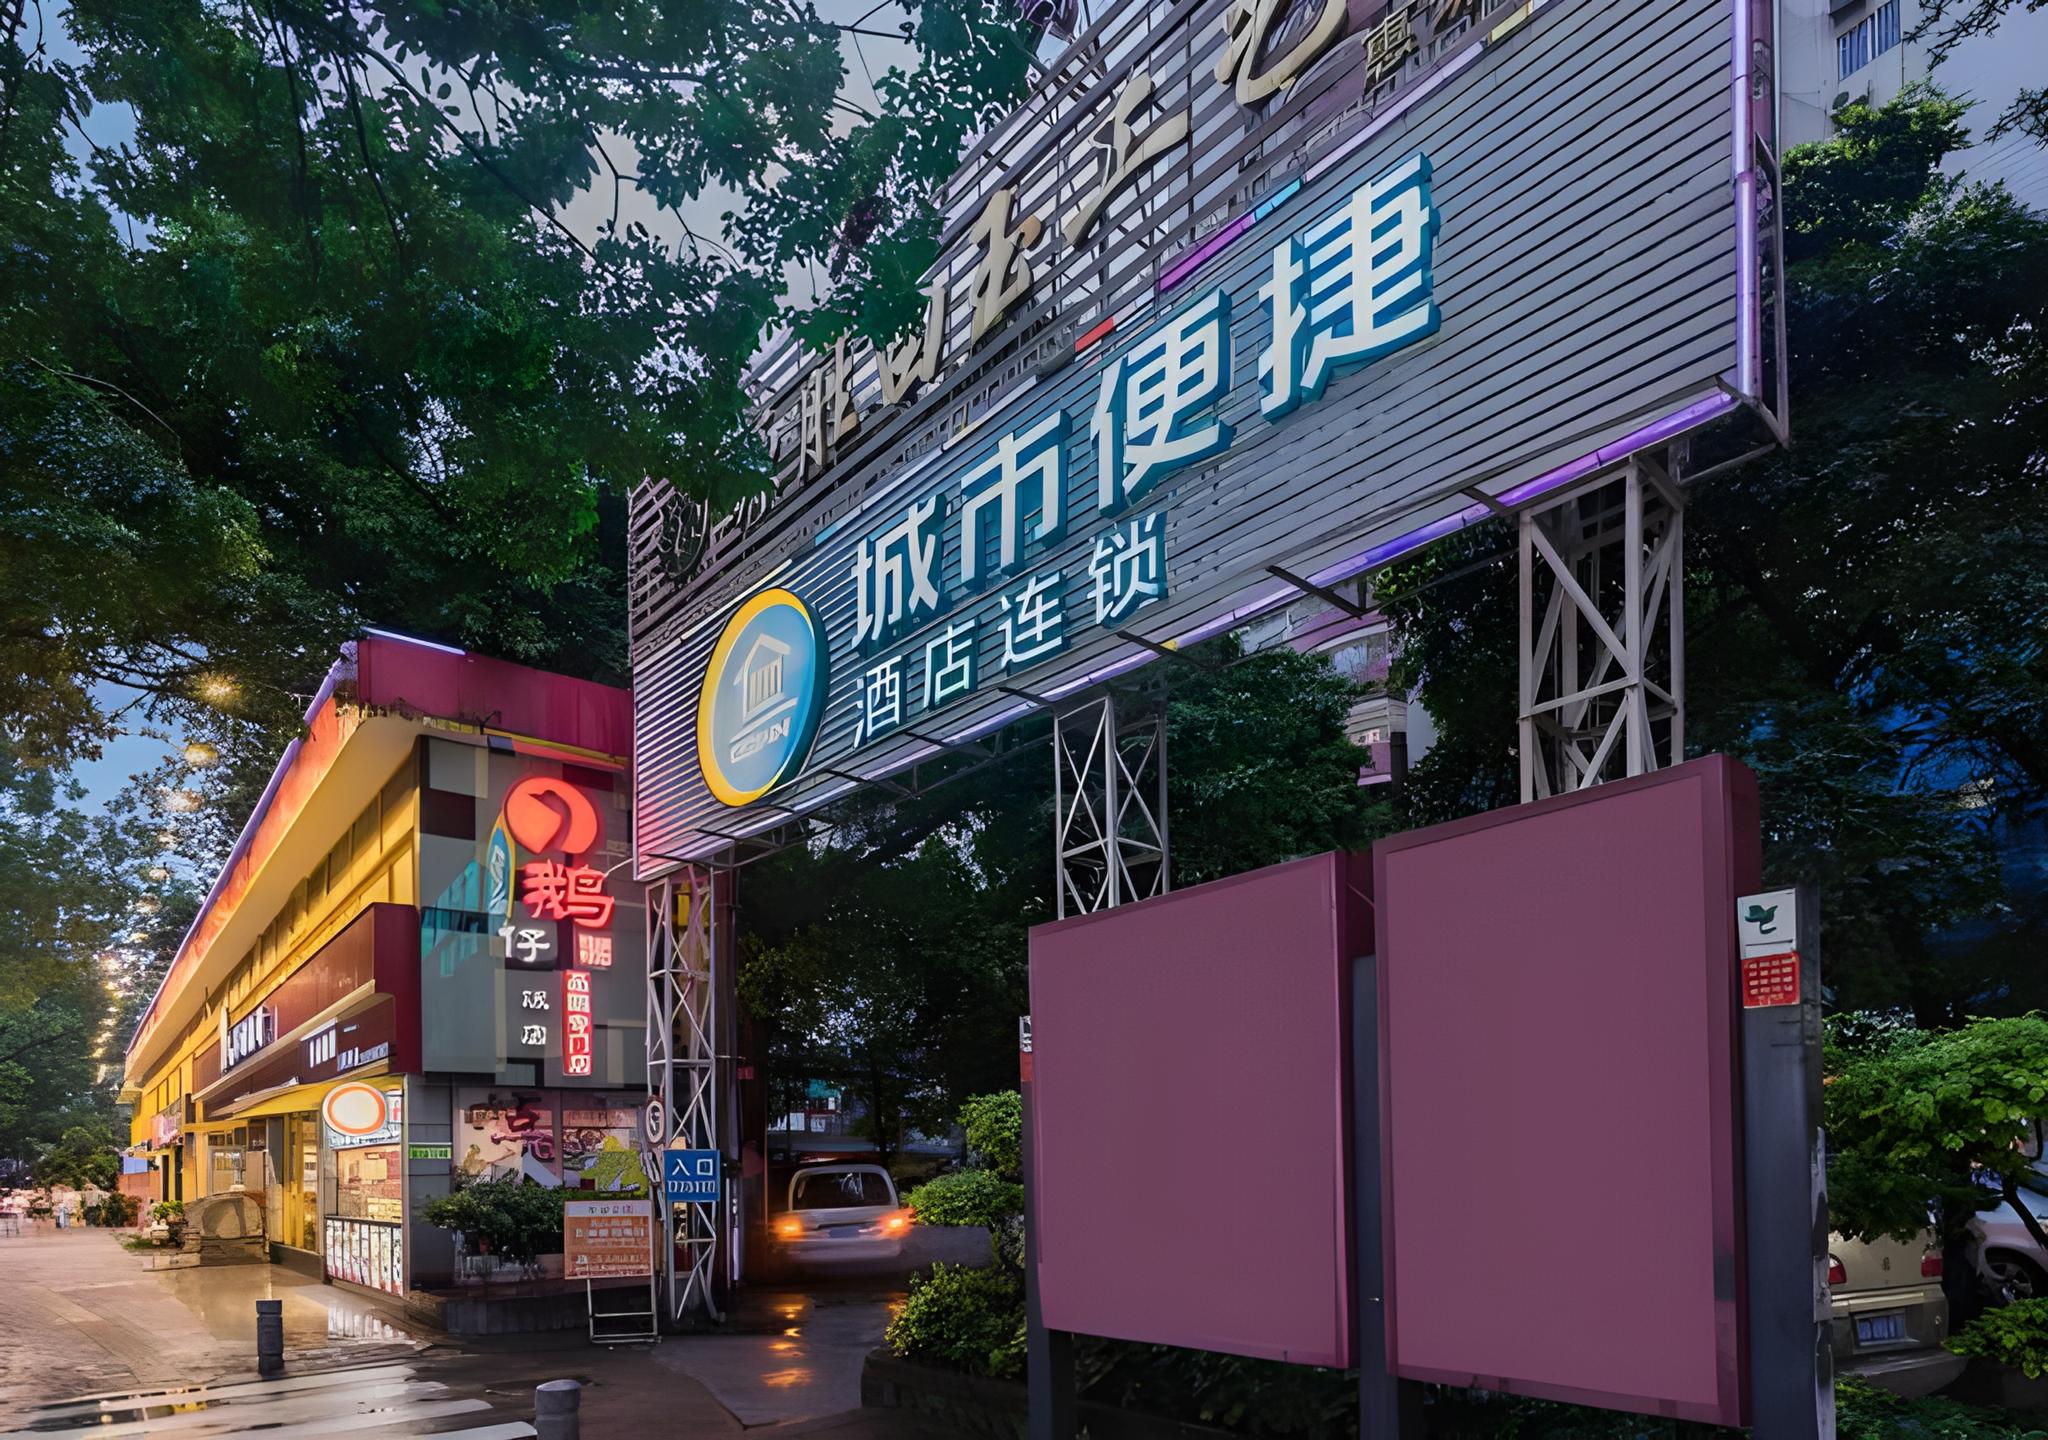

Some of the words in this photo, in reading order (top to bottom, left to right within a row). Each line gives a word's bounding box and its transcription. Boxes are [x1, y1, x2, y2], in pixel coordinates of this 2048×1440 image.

[851, 153, 1438, 645] 城市便捷
[853, 513, 1162, 747] 酒店连锁
[522, 859, 615, 928] 鹅
[672, 1158, 714, 1176] 入口
